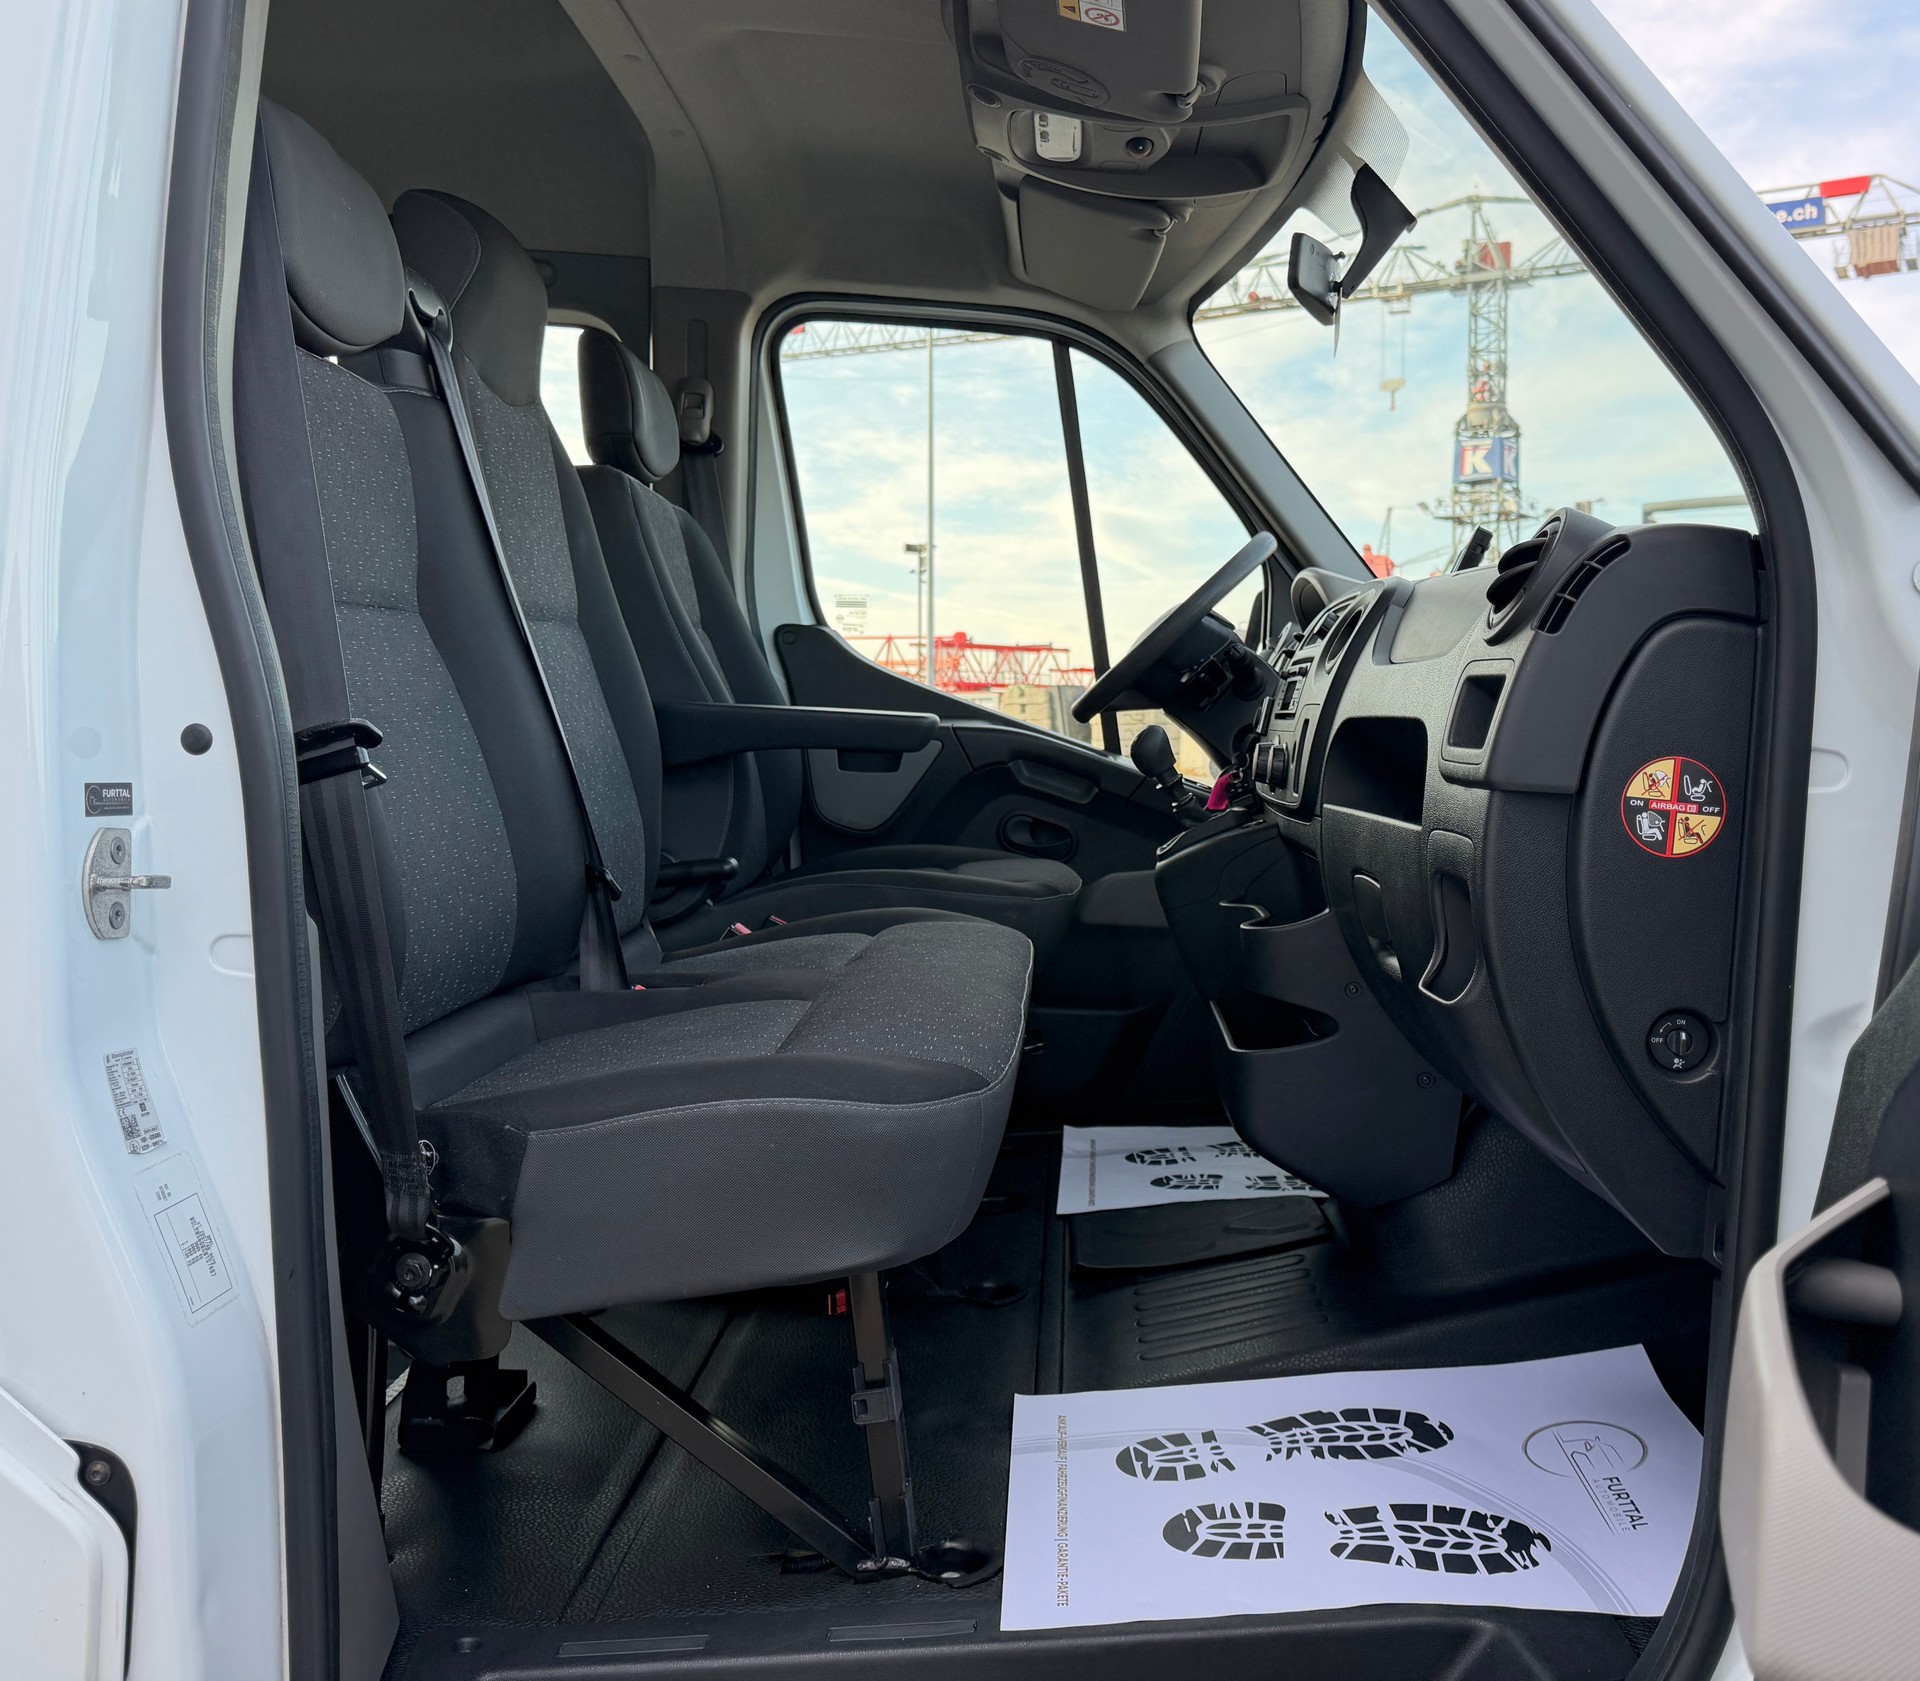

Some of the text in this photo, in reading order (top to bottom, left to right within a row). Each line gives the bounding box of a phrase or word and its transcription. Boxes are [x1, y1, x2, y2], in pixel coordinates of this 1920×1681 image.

[1461, 445, 1492, 476] K
[102, 788, 130, 798] FURTTAL
[1629, 799, 1720, 814] ON AIRBAG OFF
[1057, 1464, 1068, 1537] FAHRZEUGFINANZIERUNG
[1593, 1479, 1631, 1532] AUTOMOBILE
[1602, 1476, 1648, 1531] FURTTAL
[1057, 1542, 1068, 1607] GARANTIE-PAKETE
